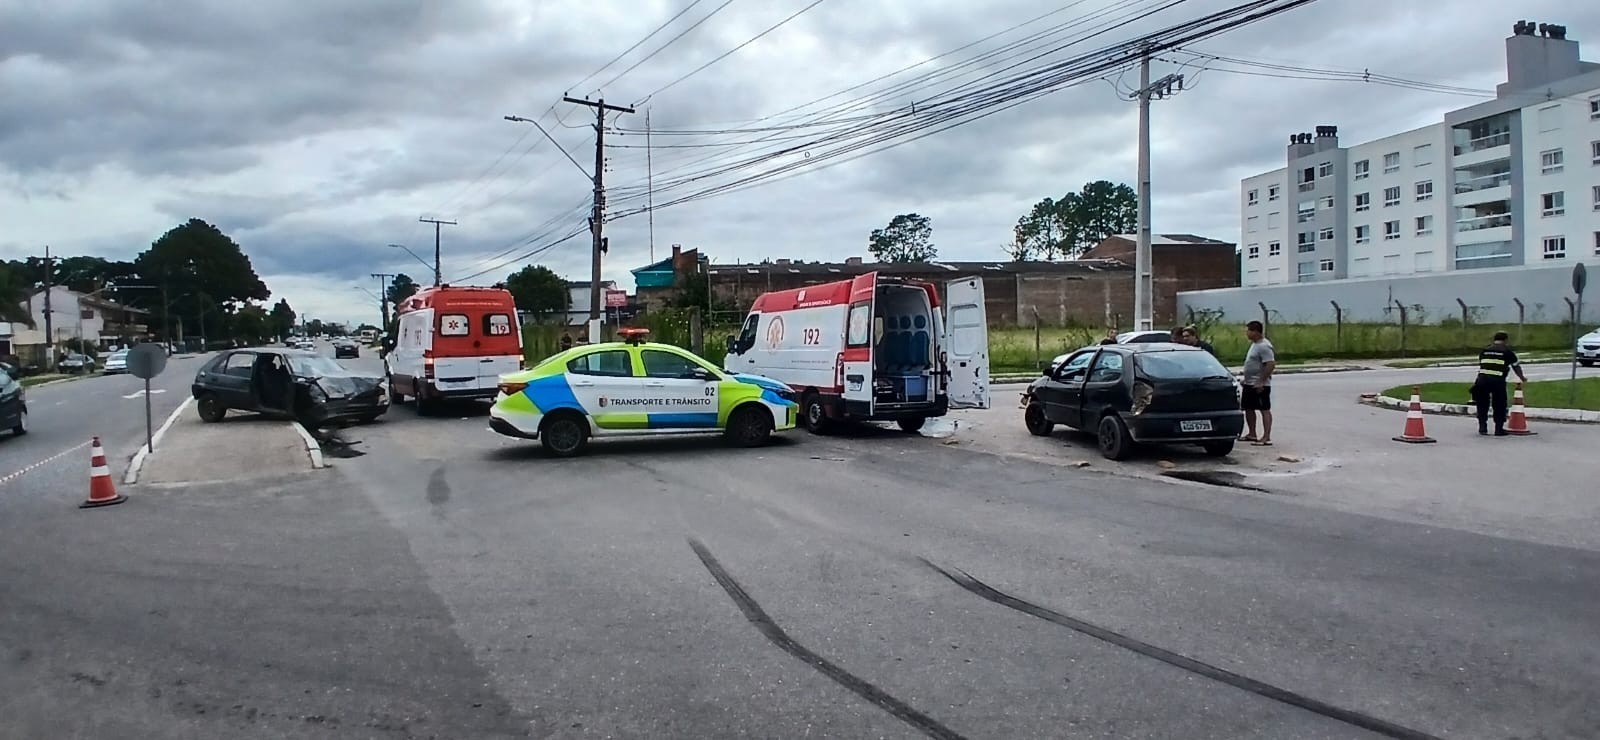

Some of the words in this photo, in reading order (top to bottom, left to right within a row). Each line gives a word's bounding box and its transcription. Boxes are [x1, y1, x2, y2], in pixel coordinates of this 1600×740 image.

[803, 328, 820, 345] 192
[705, 386, 715, 396] 02
[610, 398, 664, 406] TRANSPORTE
[665, 398, 671, 406] E
[672, 397, 711, 406] TRÂNSITO
